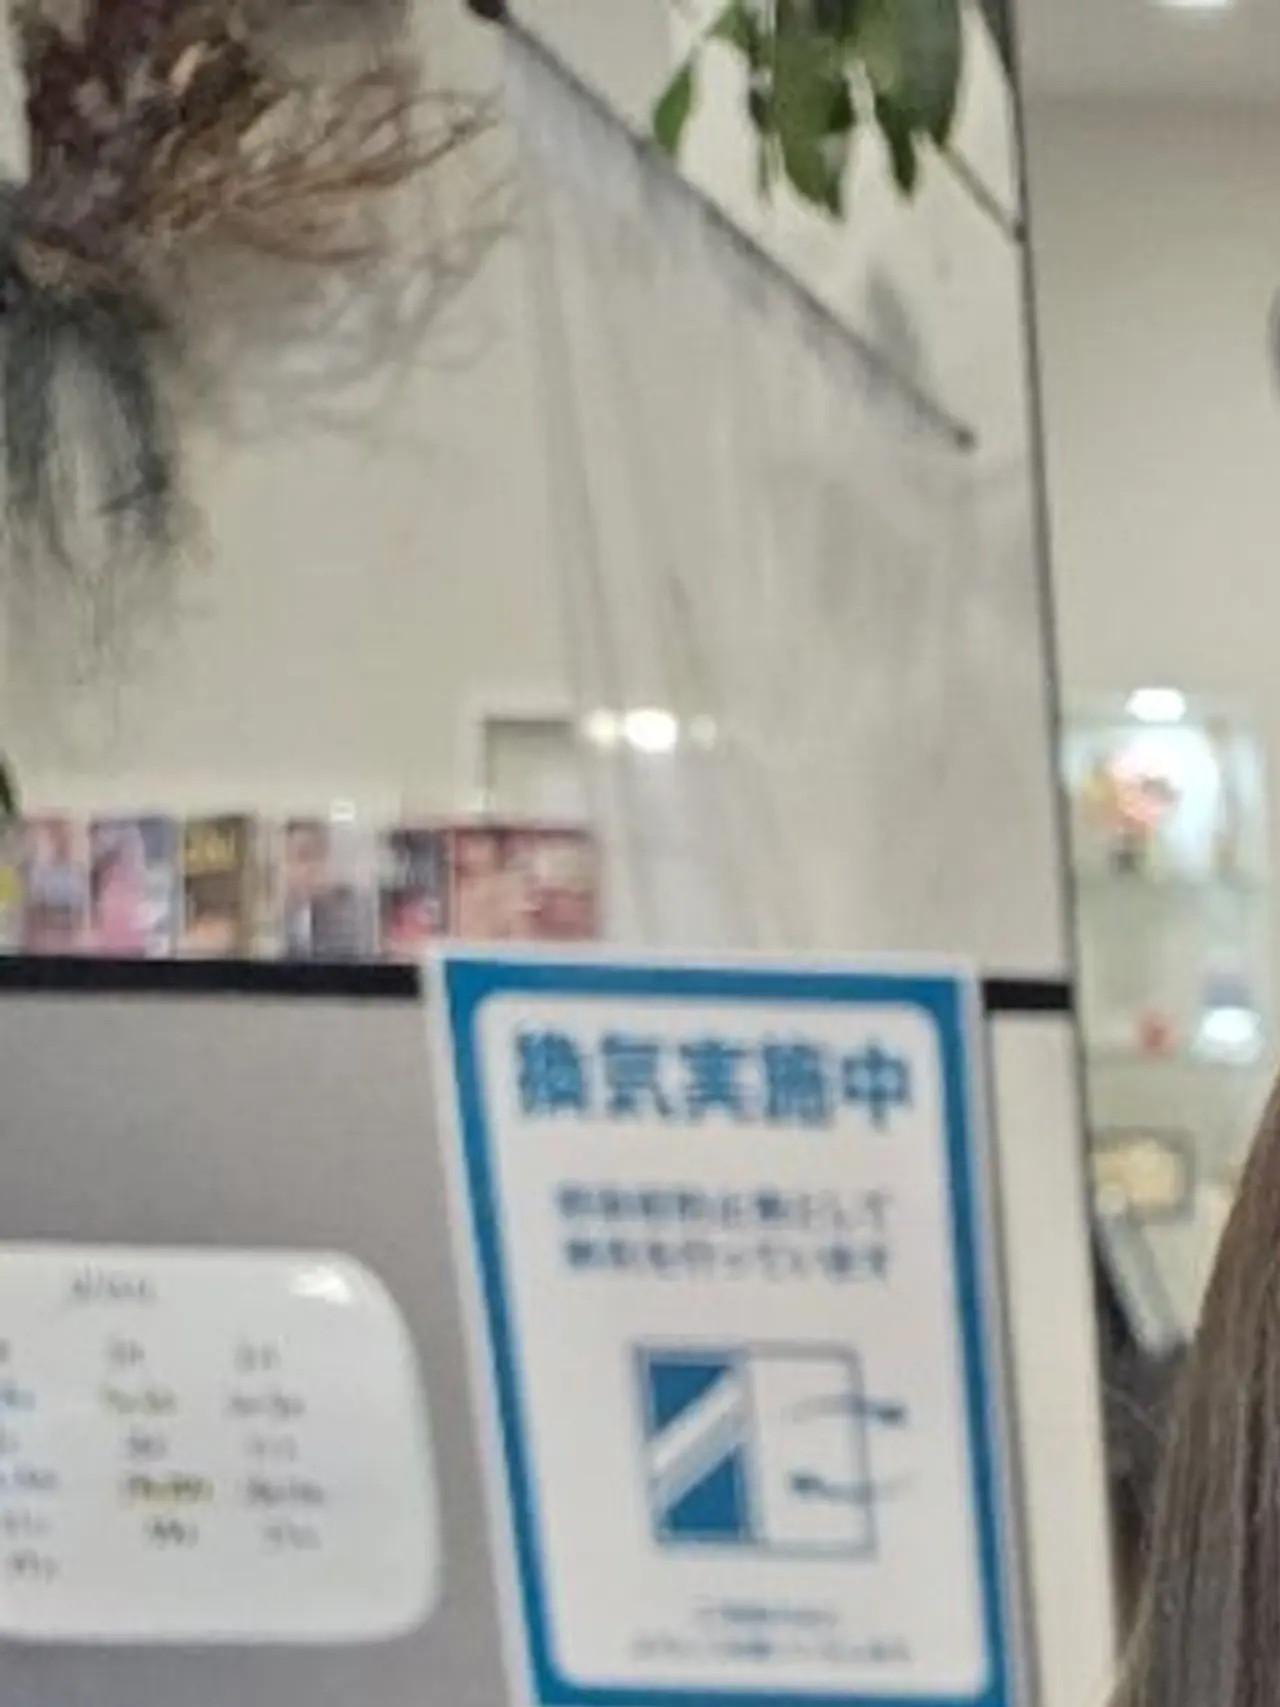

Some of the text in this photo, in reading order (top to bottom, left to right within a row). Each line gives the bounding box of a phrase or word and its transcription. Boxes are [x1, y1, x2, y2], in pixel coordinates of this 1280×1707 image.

[514, 1026, 912, 1130] 換気実施中
